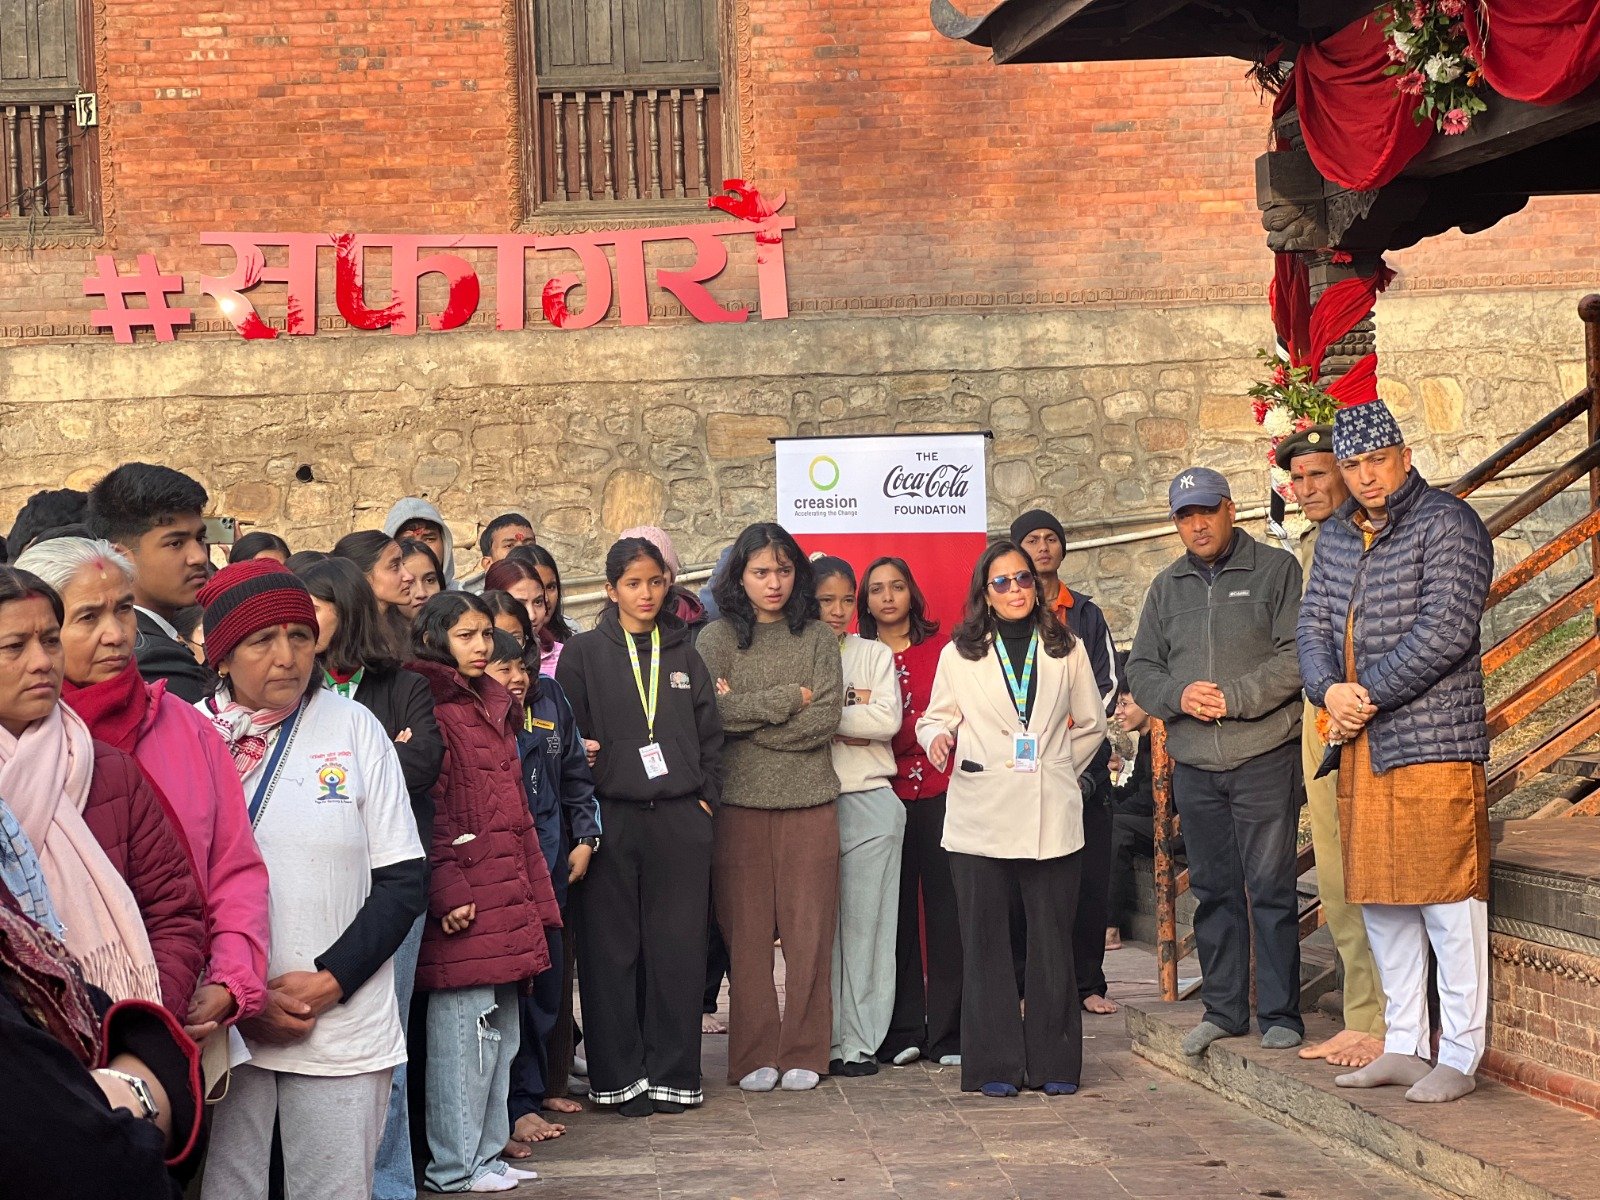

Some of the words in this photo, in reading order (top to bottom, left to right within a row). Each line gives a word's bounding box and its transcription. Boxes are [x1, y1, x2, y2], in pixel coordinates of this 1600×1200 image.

[916, 452, 938, 461] THE
[882, 464, 973, 498] Coca-Cola
[794, 494, 857, 509] creasion
[838, 509, 858, 517] Change
[894, 505, 966, 515] FOUNDATION
